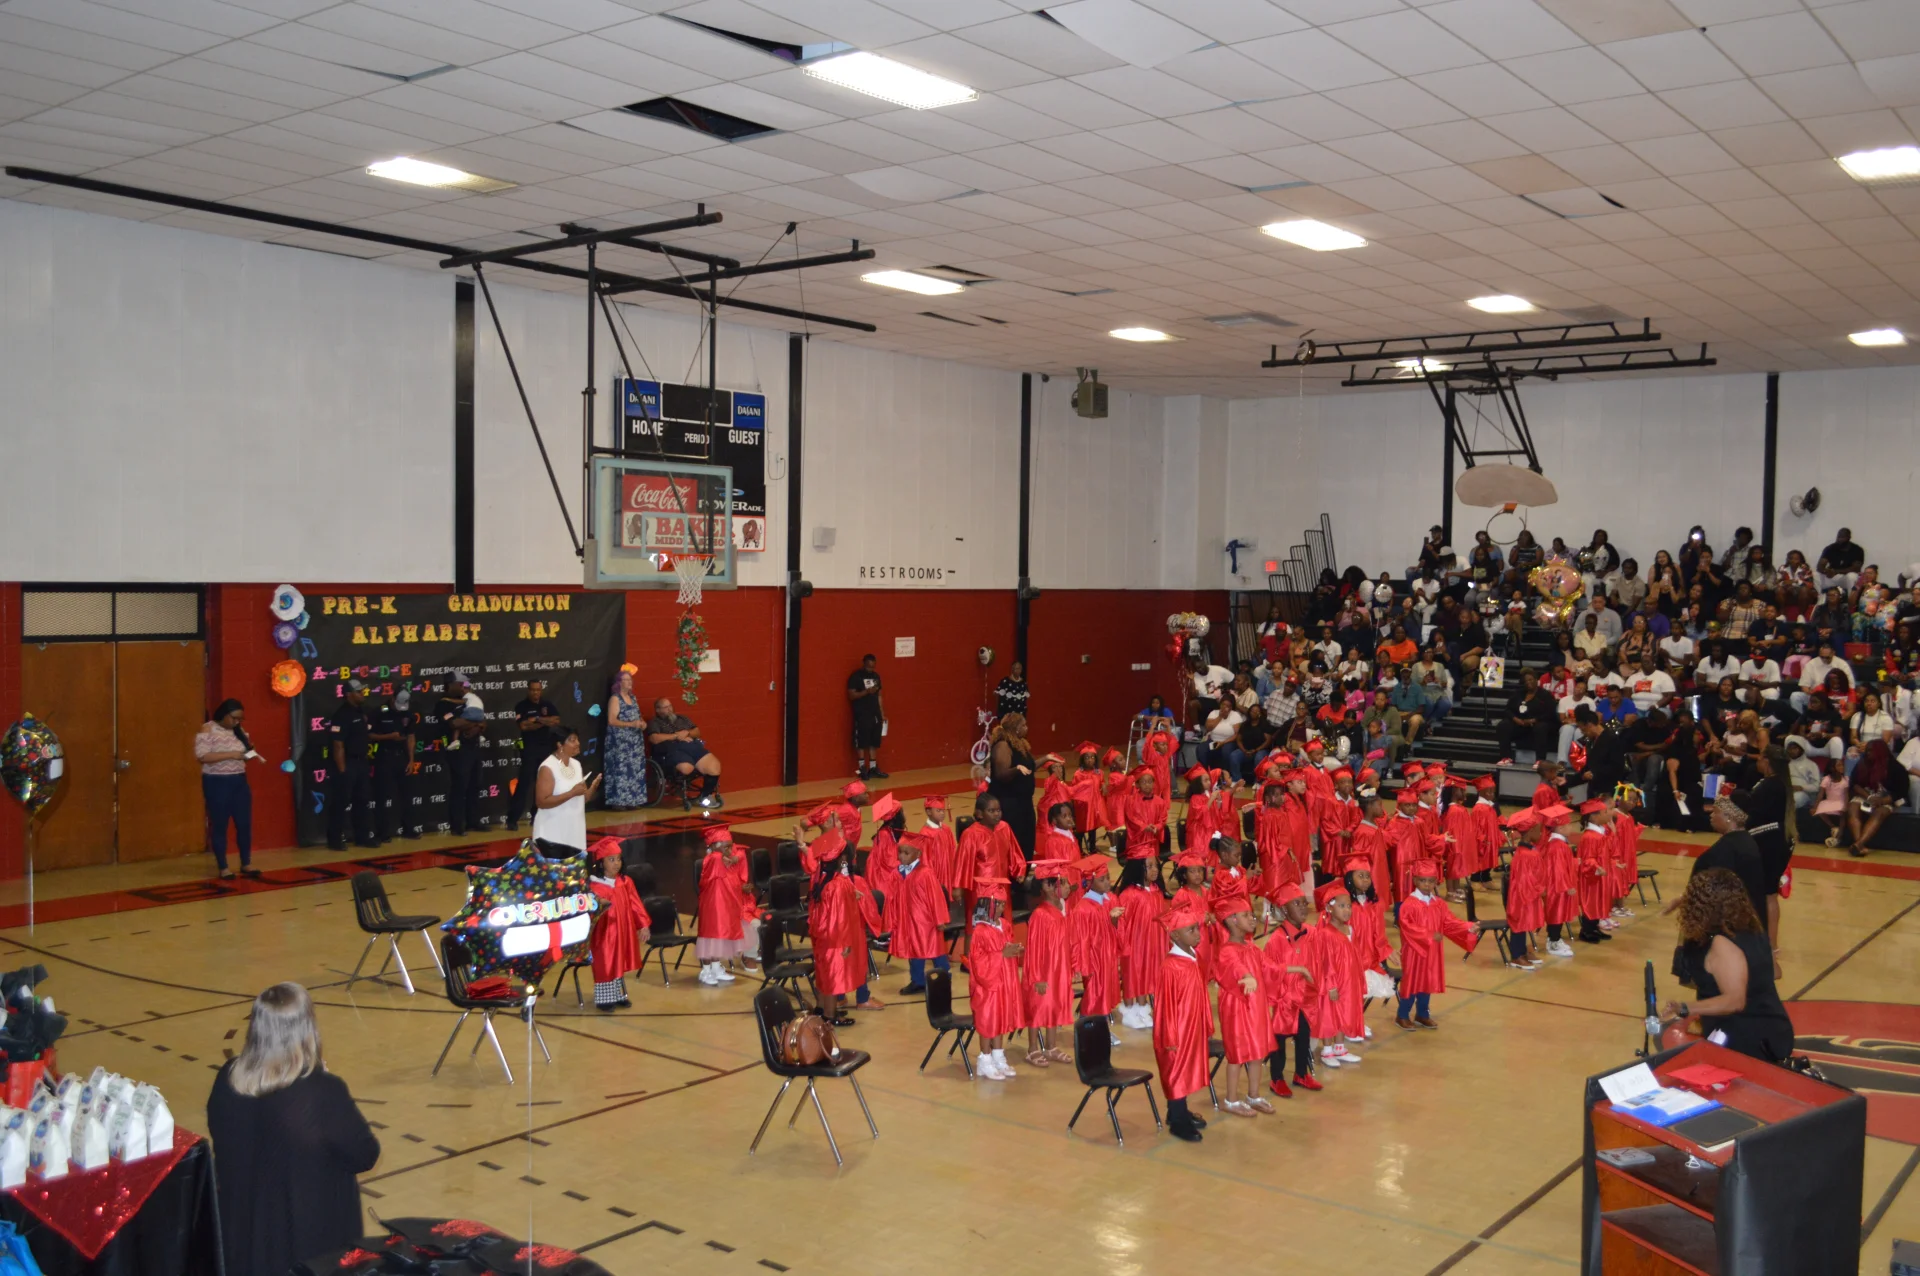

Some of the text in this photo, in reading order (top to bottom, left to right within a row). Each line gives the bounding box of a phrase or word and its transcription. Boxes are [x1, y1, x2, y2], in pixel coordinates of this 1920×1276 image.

[632, 419, 664, 437] HOME
[684, 432, 710, 445] PERIOD
[728, 428, 760, 446] GUEST
[860, 566, 943, 580] RESTROOMS
[322, 594, 571, 615] PRE-K GRADUATION
[352, 621, 561, 645] ALPHABET RAP
[485, 664, 501, 673] WILL
[505, 664, 515, 672] BE
[517, 662, 531, 671] THE
[533, 661, 555, 670] PLACE
[557, 660, 571, 669] FOR
[573, 659, 587, 667] ME!
[485, 681, 505, 690] BEST
[498, 759, 508, 767] TO
[430, 794, 446, 803] THE
[488, 894, 599, 926] CONGRATULATIONS
